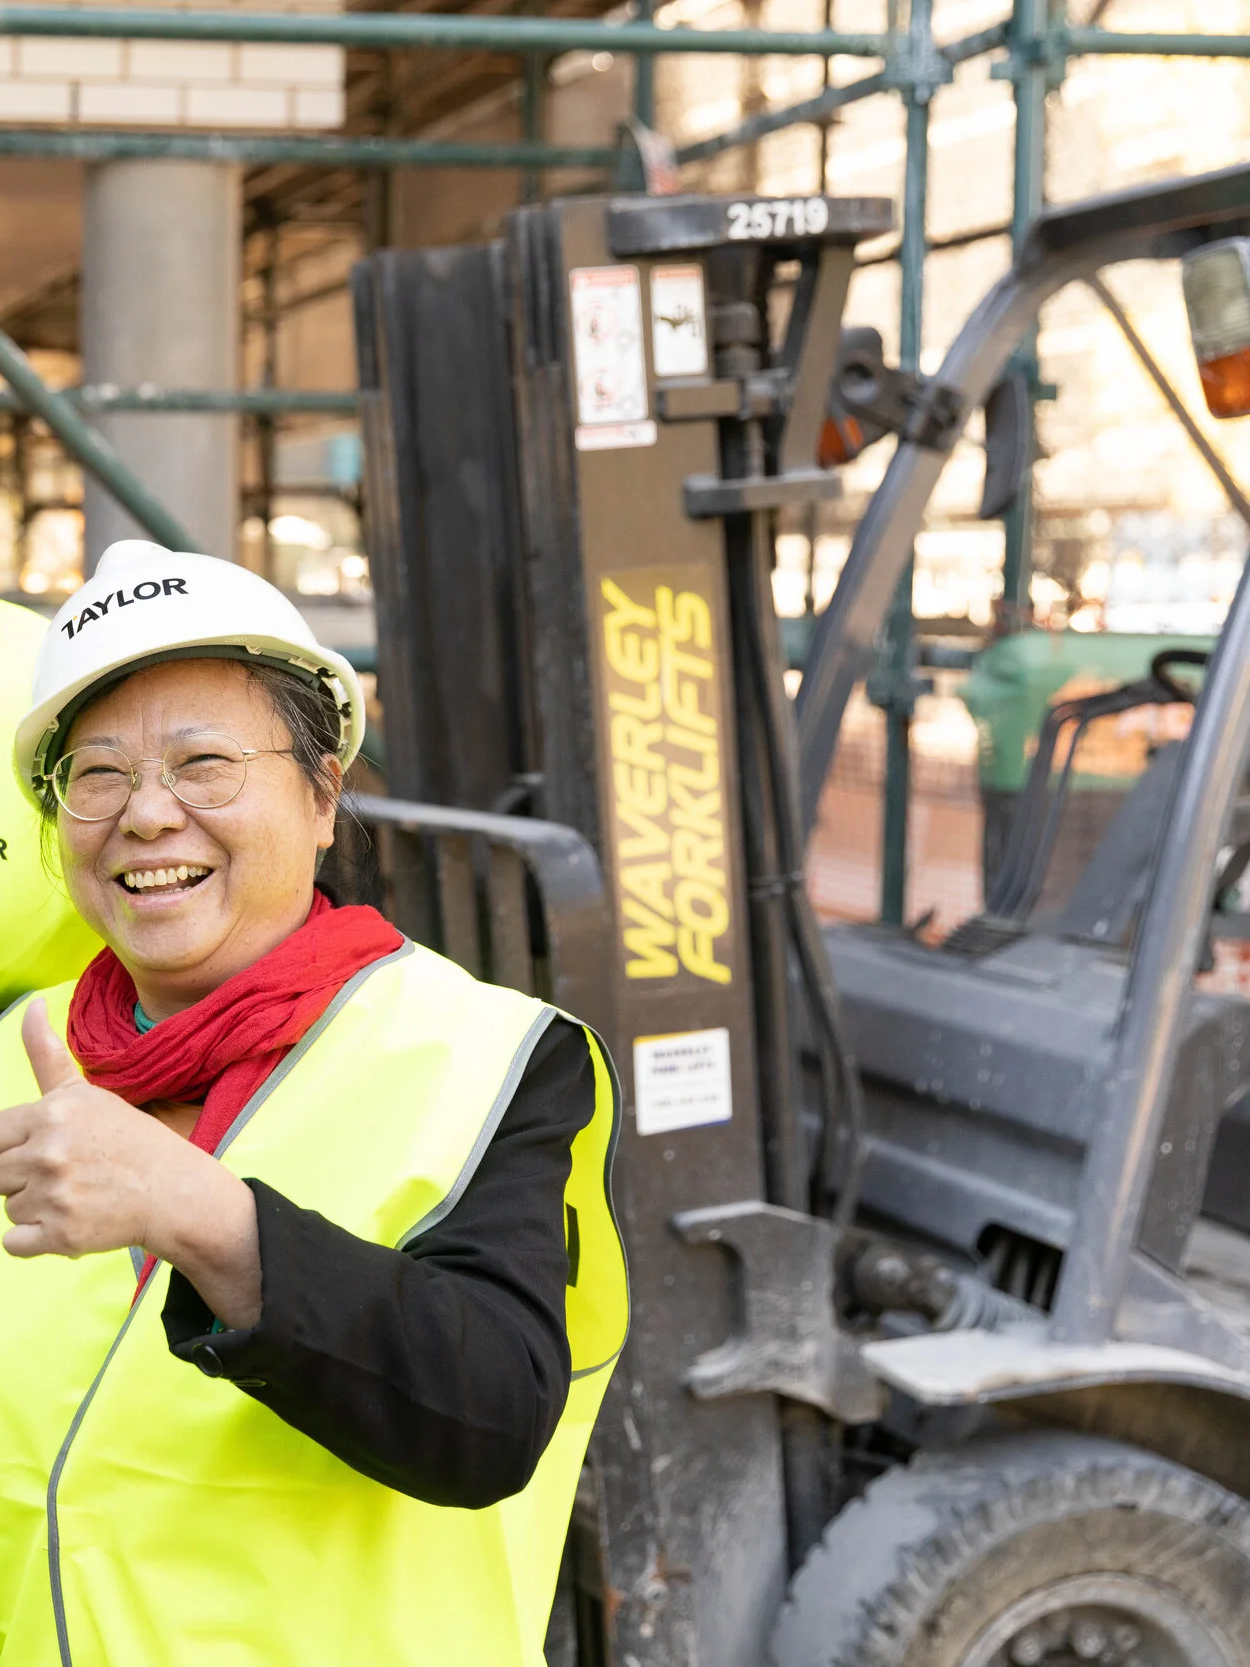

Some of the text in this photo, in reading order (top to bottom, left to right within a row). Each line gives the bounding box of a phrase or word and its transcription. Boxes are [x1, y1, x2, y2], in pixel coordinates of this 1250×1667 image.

[727, 197, 829, 240] 25719
[60, 577, 190, 640] TAYLOR
[601, 576, 679, 979] WAVERLEY
[654, 585, 733, 984] FORKLIFTS
